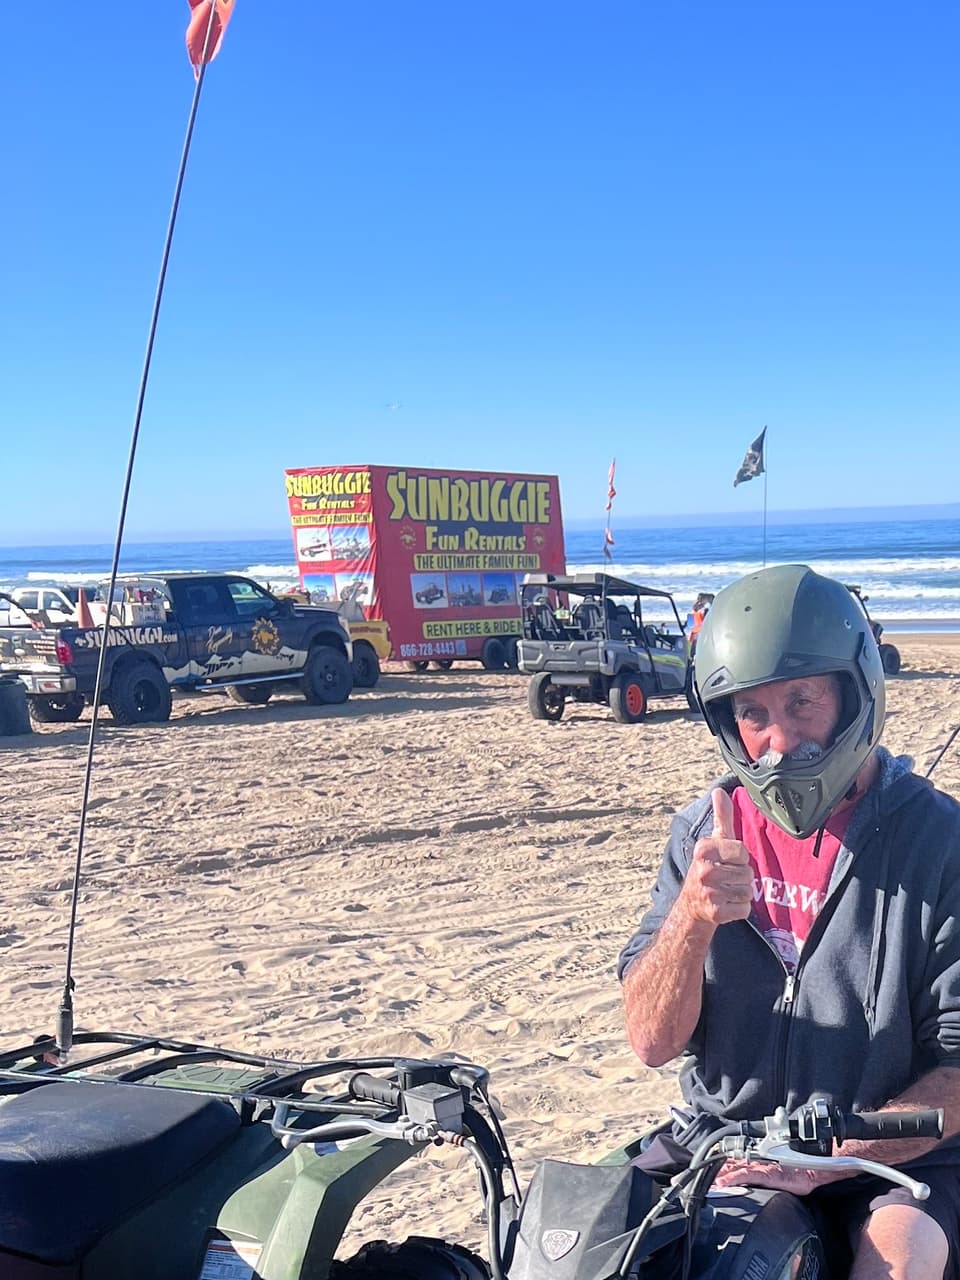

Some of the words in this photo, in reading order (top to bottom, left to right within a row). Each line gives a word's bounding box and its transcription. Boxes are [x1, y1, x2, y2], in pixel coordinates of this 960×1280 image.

[285, 472, 372, 497] SUNBUGGIE
[386, 471, 551, 524] SUNBUGGIE
[416, 555, 434, 569] THE
[436, 555, 480, 570] ULTIMATE
[482, 555, 514, 569] FAMILY
[517, 555, 538, 569] FUN!
[426, 623, 454, 637] RENT
[455, 622, 482, 635] HERE
[483, 622, 491, 634] &
[493, 620, 516, 633] RIDE
